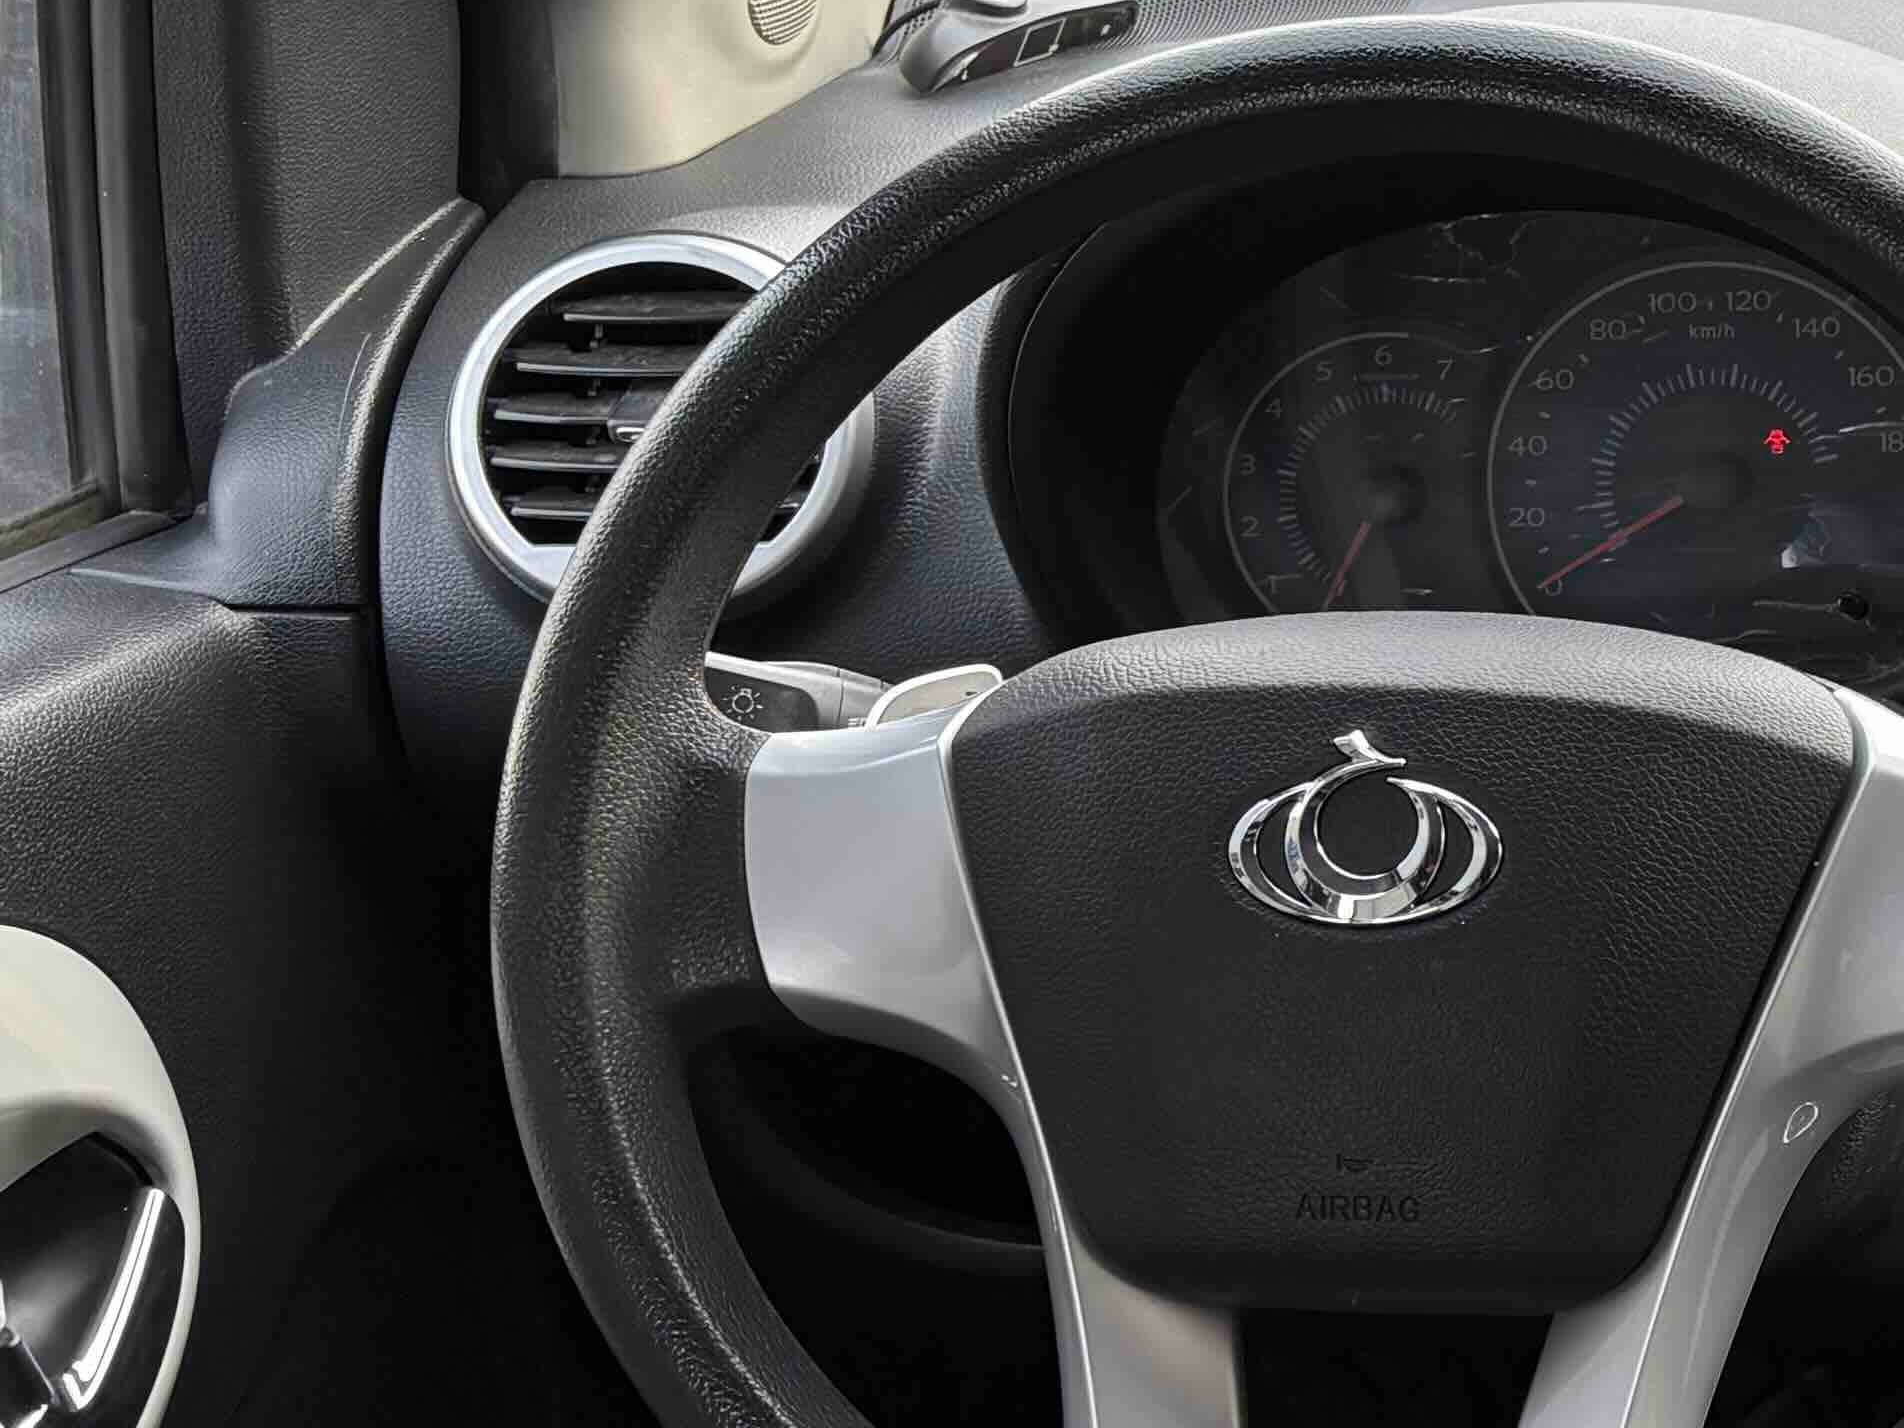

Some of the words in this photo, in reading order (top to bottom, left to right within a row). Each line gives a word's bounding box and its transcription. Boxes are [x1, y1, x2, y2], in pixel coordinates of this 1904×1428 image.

[1648, 290, 1697, 315] 100
[1725, 290, 1773, 313] 120
[1589, 318, 1627, 341] 80
[1688, 322, 1737, 341] km/h
[1793, 315, 1841, 339] 140
[1373, 344, 1394, 366] 6
[1315, 361, 1335, 382] 5
[1435, 358, 1456, 381] 7
[1538, 367, 1575, 392] 60
[1847, 365, 1895, 388] 160
[1264, 397, 1284, 420] 4
[1507, 435, 1548, 457] 40
[1239, 453, 1257, 476] 3
[1239, 515, 1262, 538] 2
[1508, 507, 1547, 529] 20
[1295, 1193, 1420, 1222] AIRBAG
